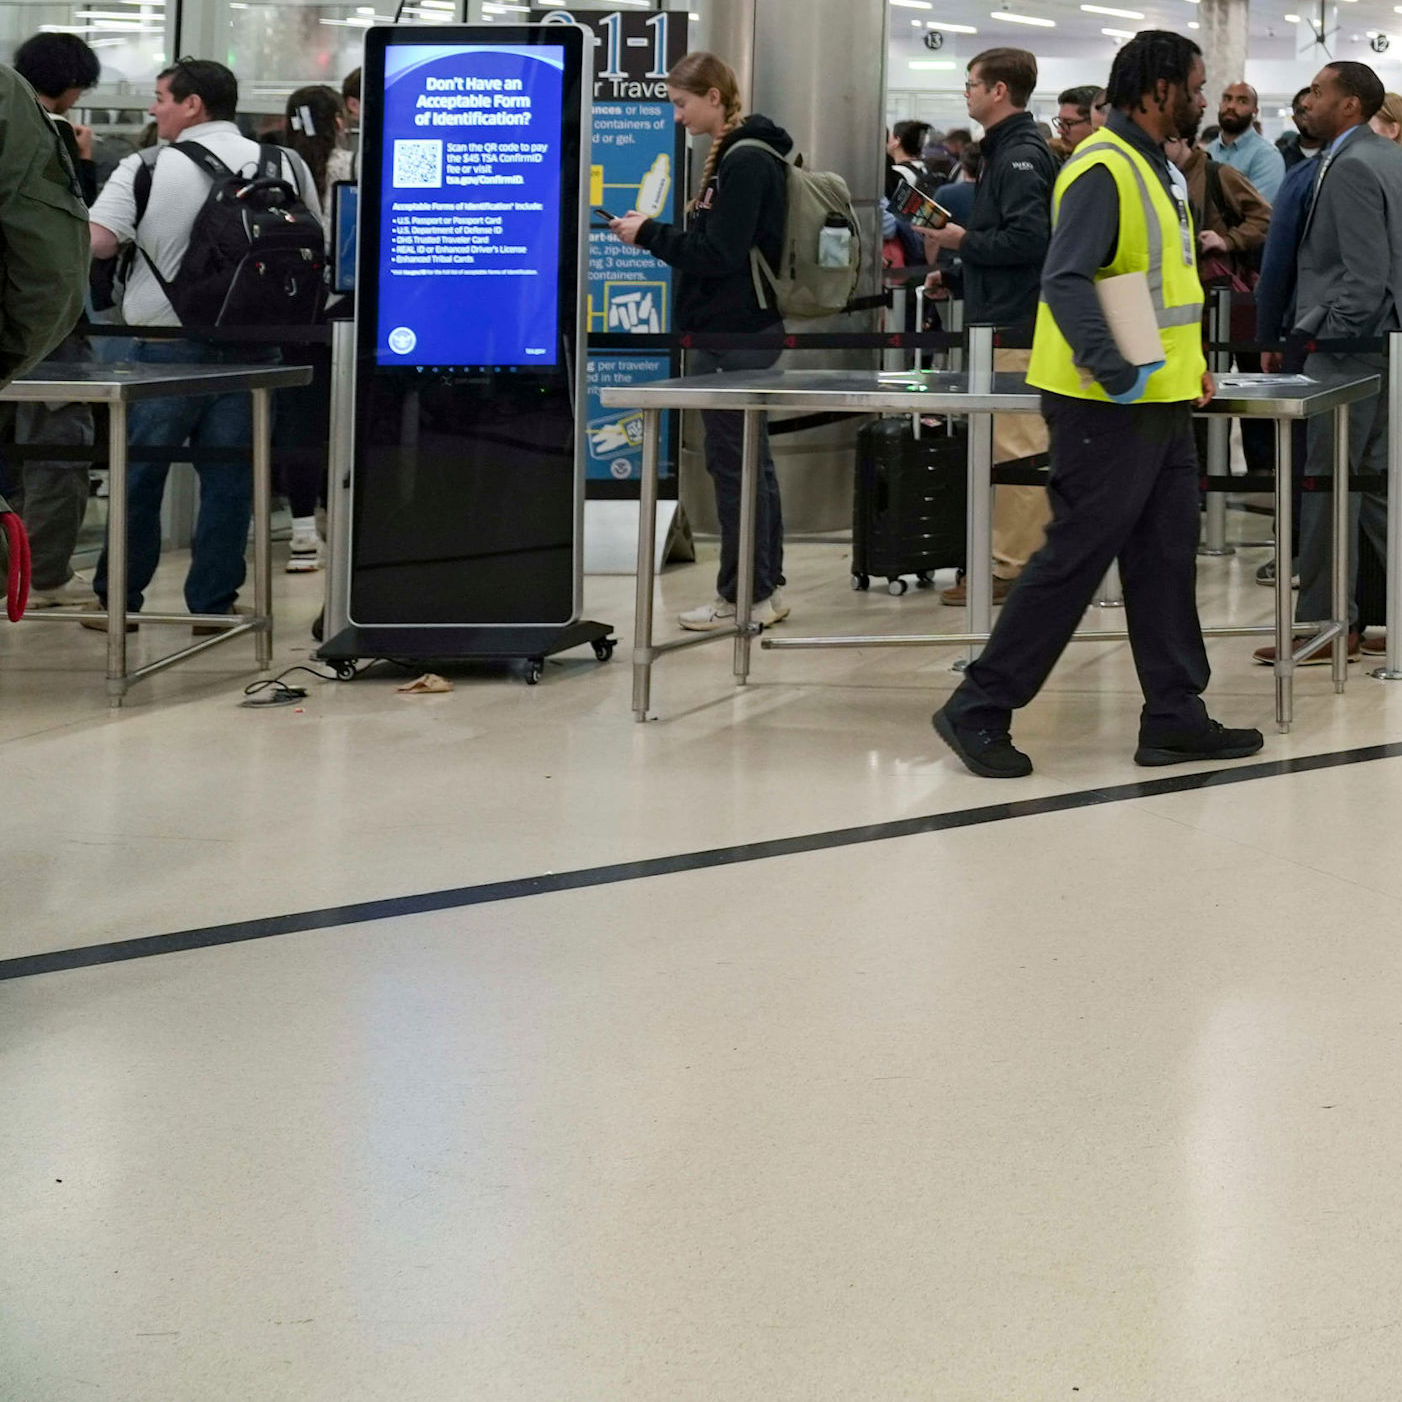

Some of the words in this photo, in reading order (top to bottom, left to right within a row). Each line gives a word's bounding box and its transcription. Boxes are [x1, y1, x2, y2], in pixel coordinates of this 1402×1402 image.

[427, 77, 464, 90] Don't
[466, 78, 502, 90] Have
[504, 79, 522, 90] an
[608, 78, 668, 98] Trave
[416, 94, 491, 110] Acceptable
[494, 95, 530, 107] Form
[640, 106, 661, 115] less
[415, 112, 431, 125] of
[433, 112, 531, 125] Identification?
[594, 120, 651, 129] containers
[653, 120, 664, 129] of
[602, 135, 614, 143] or
[616, 134, 635, 145] gel.
[606, 258, 613, 267] 3
[616, 259, 655, 267] ounces
[598, 362, 615, 372] per
[619, 361, 660, 371] traveler
[614, 374, 632, 382] the
